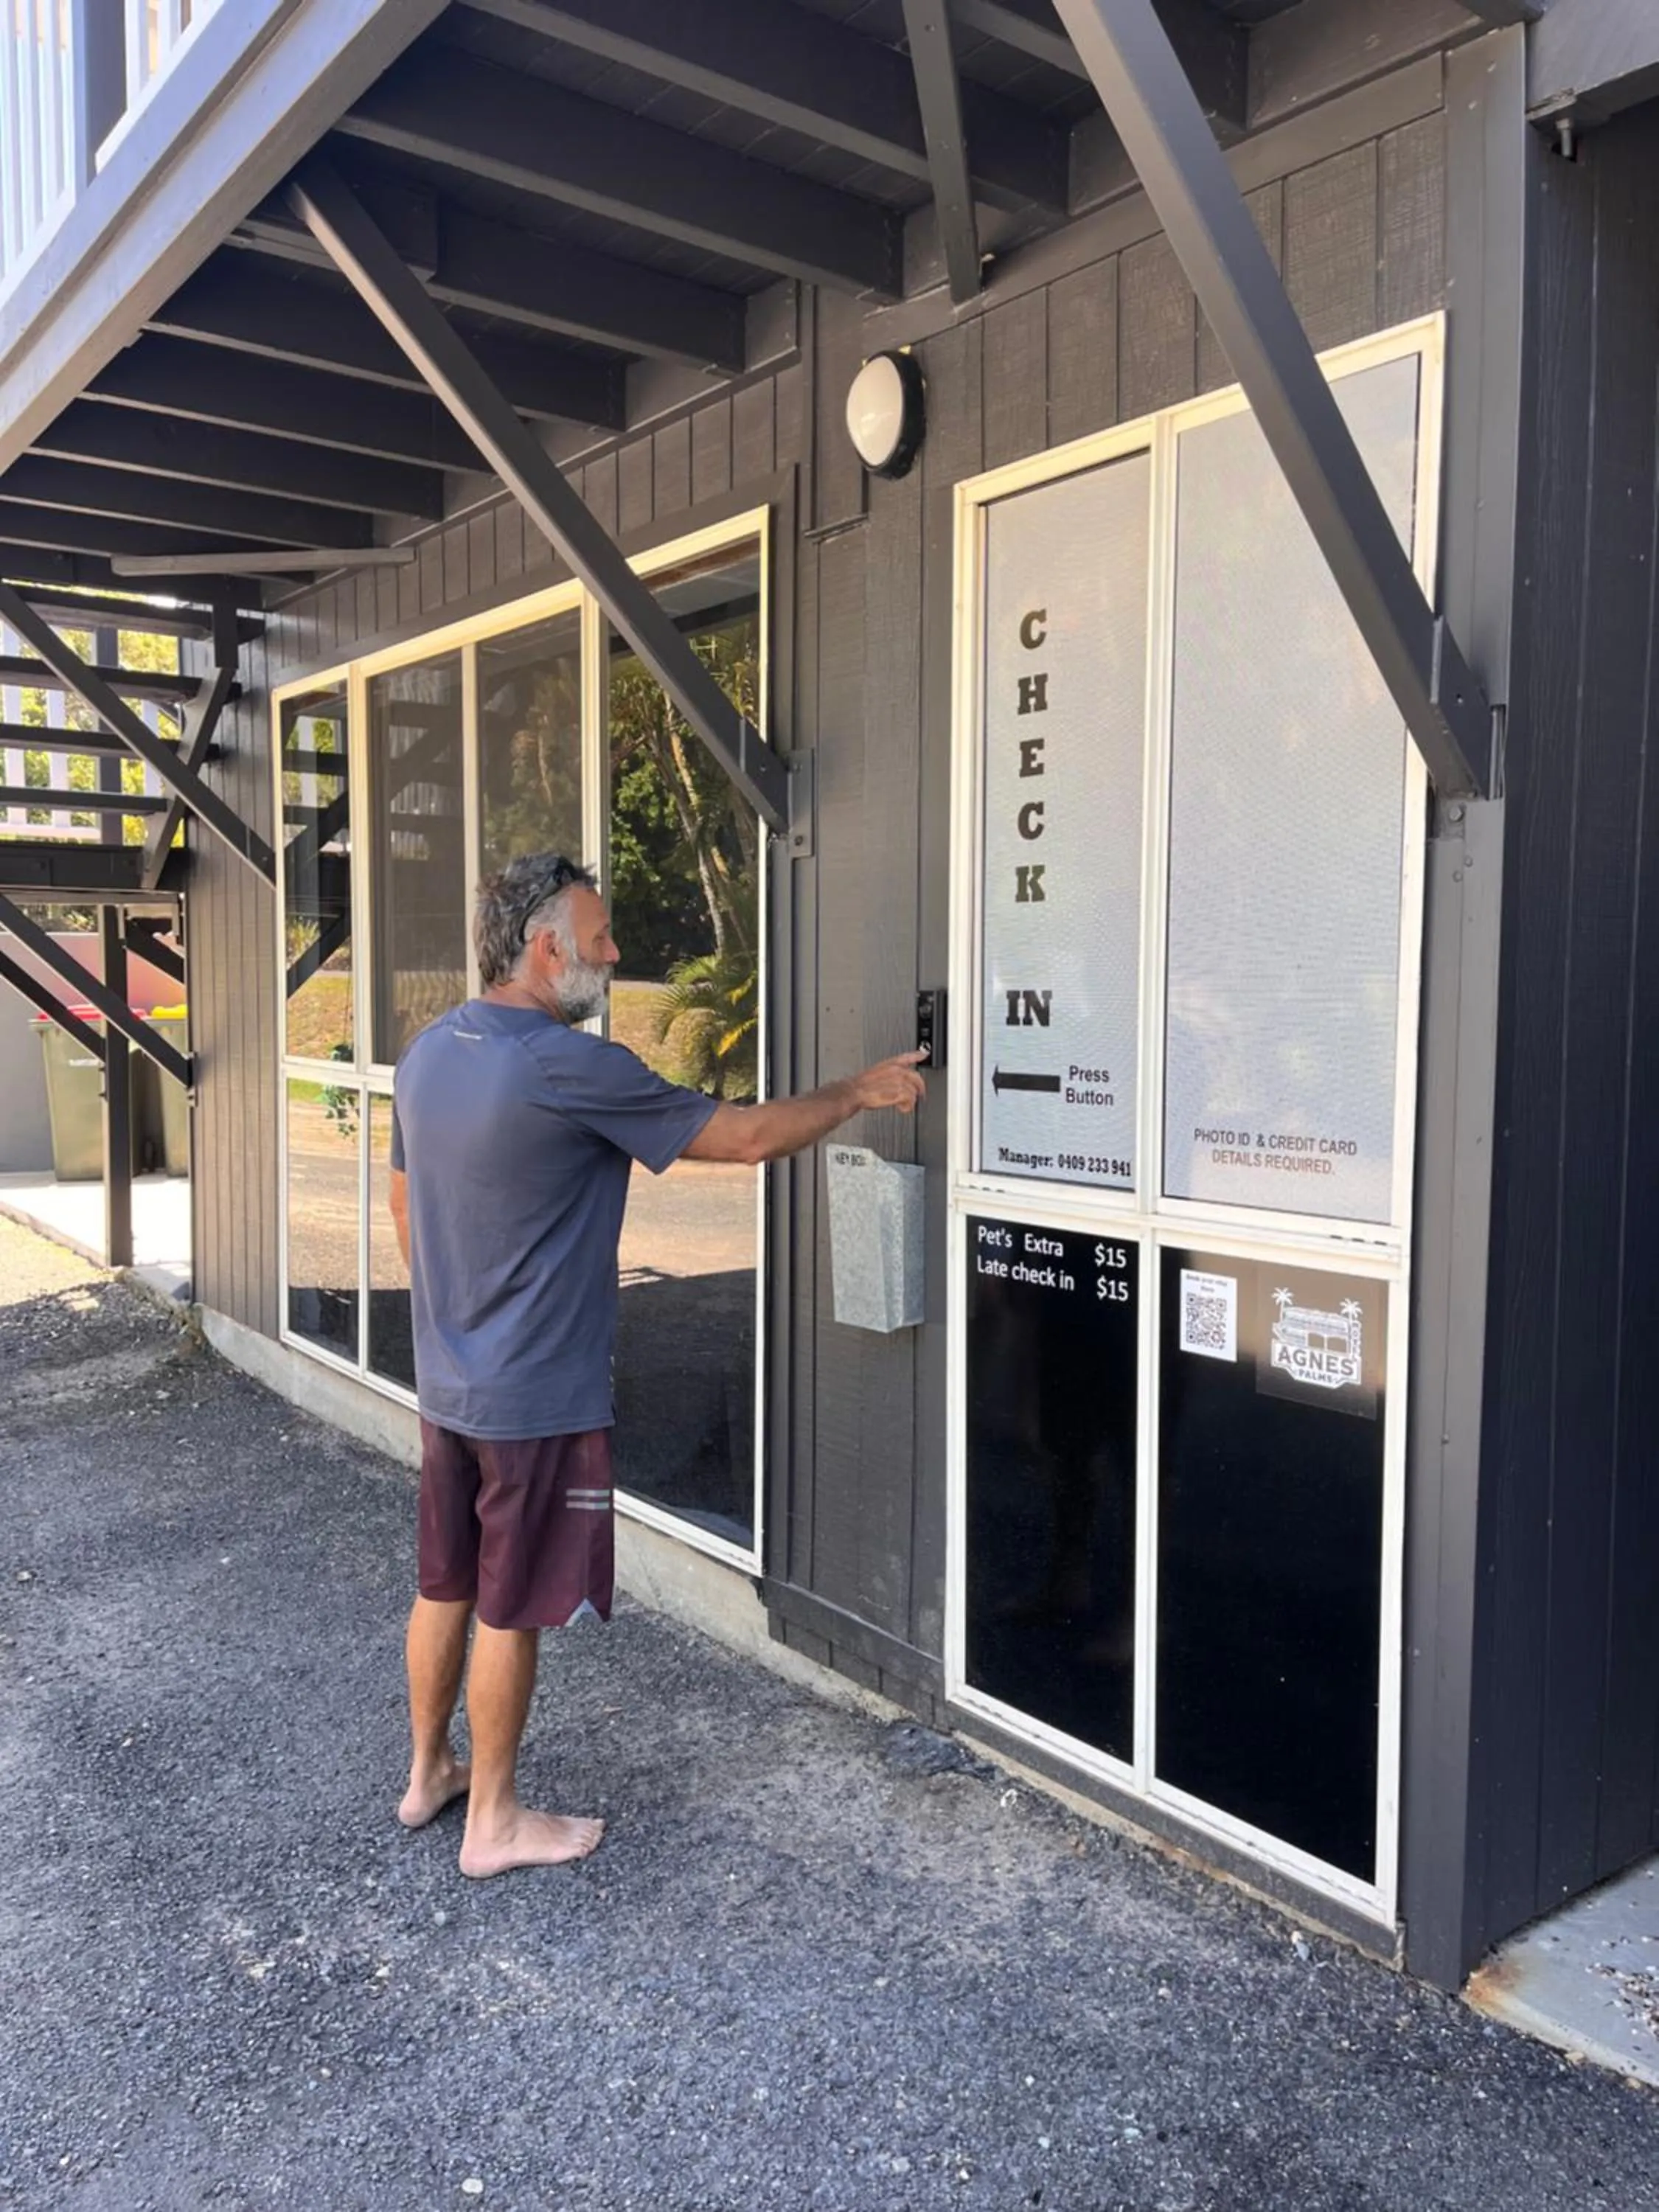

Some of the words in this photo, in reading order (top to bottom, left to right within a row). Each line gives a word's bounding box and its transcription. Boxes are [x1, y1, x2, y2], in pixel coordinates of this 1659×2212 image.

[1006, 990, 1053, 1027] IN
[1069, 1065, 1110, 1082] Press
[1065, 1088, 1114, 1106] Button
[1194, 1128, 1235, 1144] PHOTO
[1238, 1132, 1251, 1147] ID
[1256, 1133, 1265, 1148] &
[1268, 1135, 1315, 1152] CREDIT
[1318, 1139, 1357, 1156] CARD
[998, 1147, 1054, 1169] Manager:
[1058, 1154, 1086, 1171] 0409
[1088, 1156, 1110, 1174] 233
[1111, 1159, 1132, 1177] 941
[1212, 1150, 1262, 1167] DETAILS
[1265, 1154, 1335, 1175] REQUIRED.
[978, 1225, 1013, 1248] Pet's
[1024, 1233, 1064, 1257] Extra
[1094, 1242, 1127, 1269] $15
[977, 1254, 1009, 1277] Late
[1012, 1262, 1056, 1288] check
[1060, 1270, 1075, 1291] in
[1096, 1274, 1130, 1302] $15
[1278, 1346, 1354, 1376] AGNES
